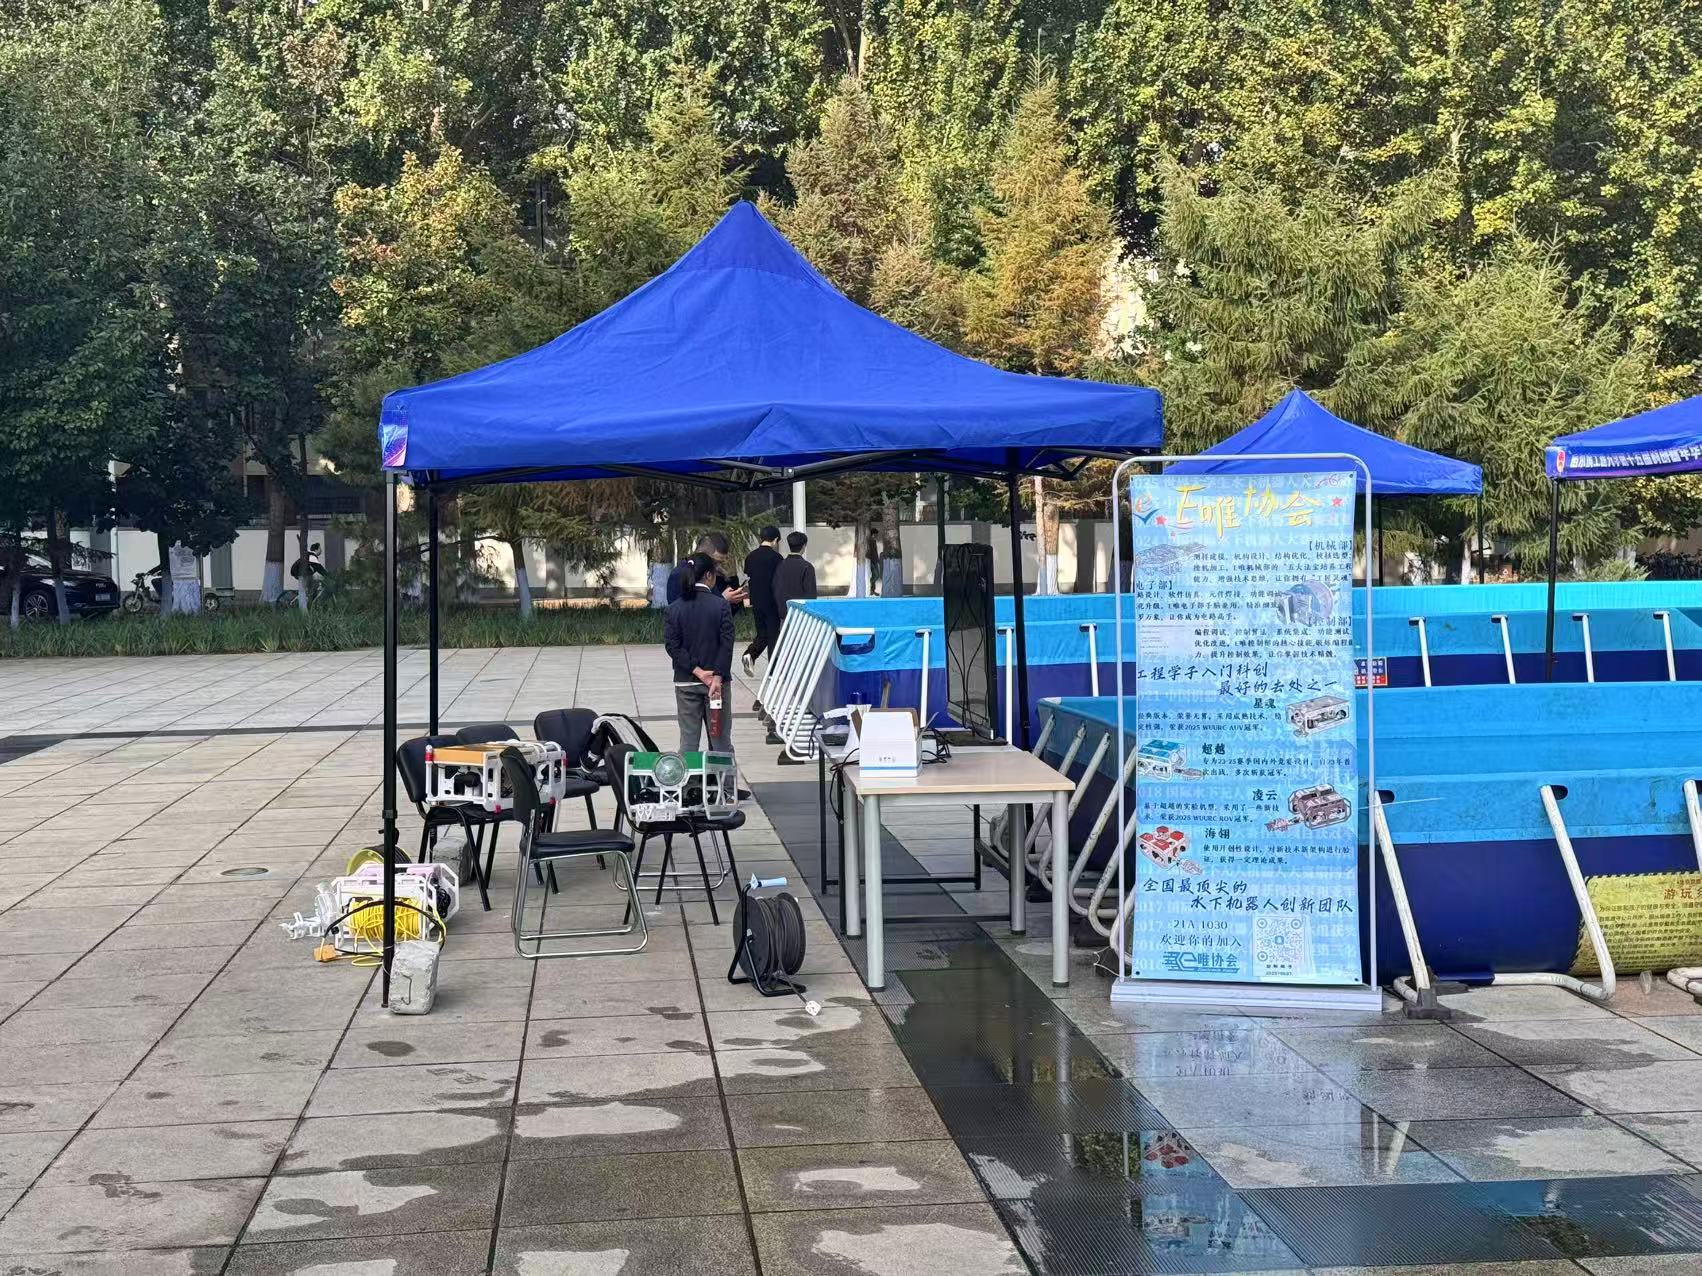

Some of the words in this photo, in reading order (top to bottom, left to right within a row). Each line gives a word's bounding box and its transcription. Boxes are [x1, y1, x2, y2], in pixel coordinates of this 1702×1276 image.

[1137, 661, 1268, 681] 工程学子入门科创
[1219, 678, 1338, 697] 最好的去处之一
[1253, 697, 1277, 709] 星魂
[1202, 742, 1226, 755] 超越
[1252, 788, 1278, 801] 凌云
[1143, 877, 1248, 895] 全国最顶尖的
[1190, 896, 1354, 913] 水下机器人创新团队
[1173, 919, 1195, 929] 21A
[1201, 920, 1228, 930] 1030
[1159, 934, 1243, 948] 欢迎你的加入
